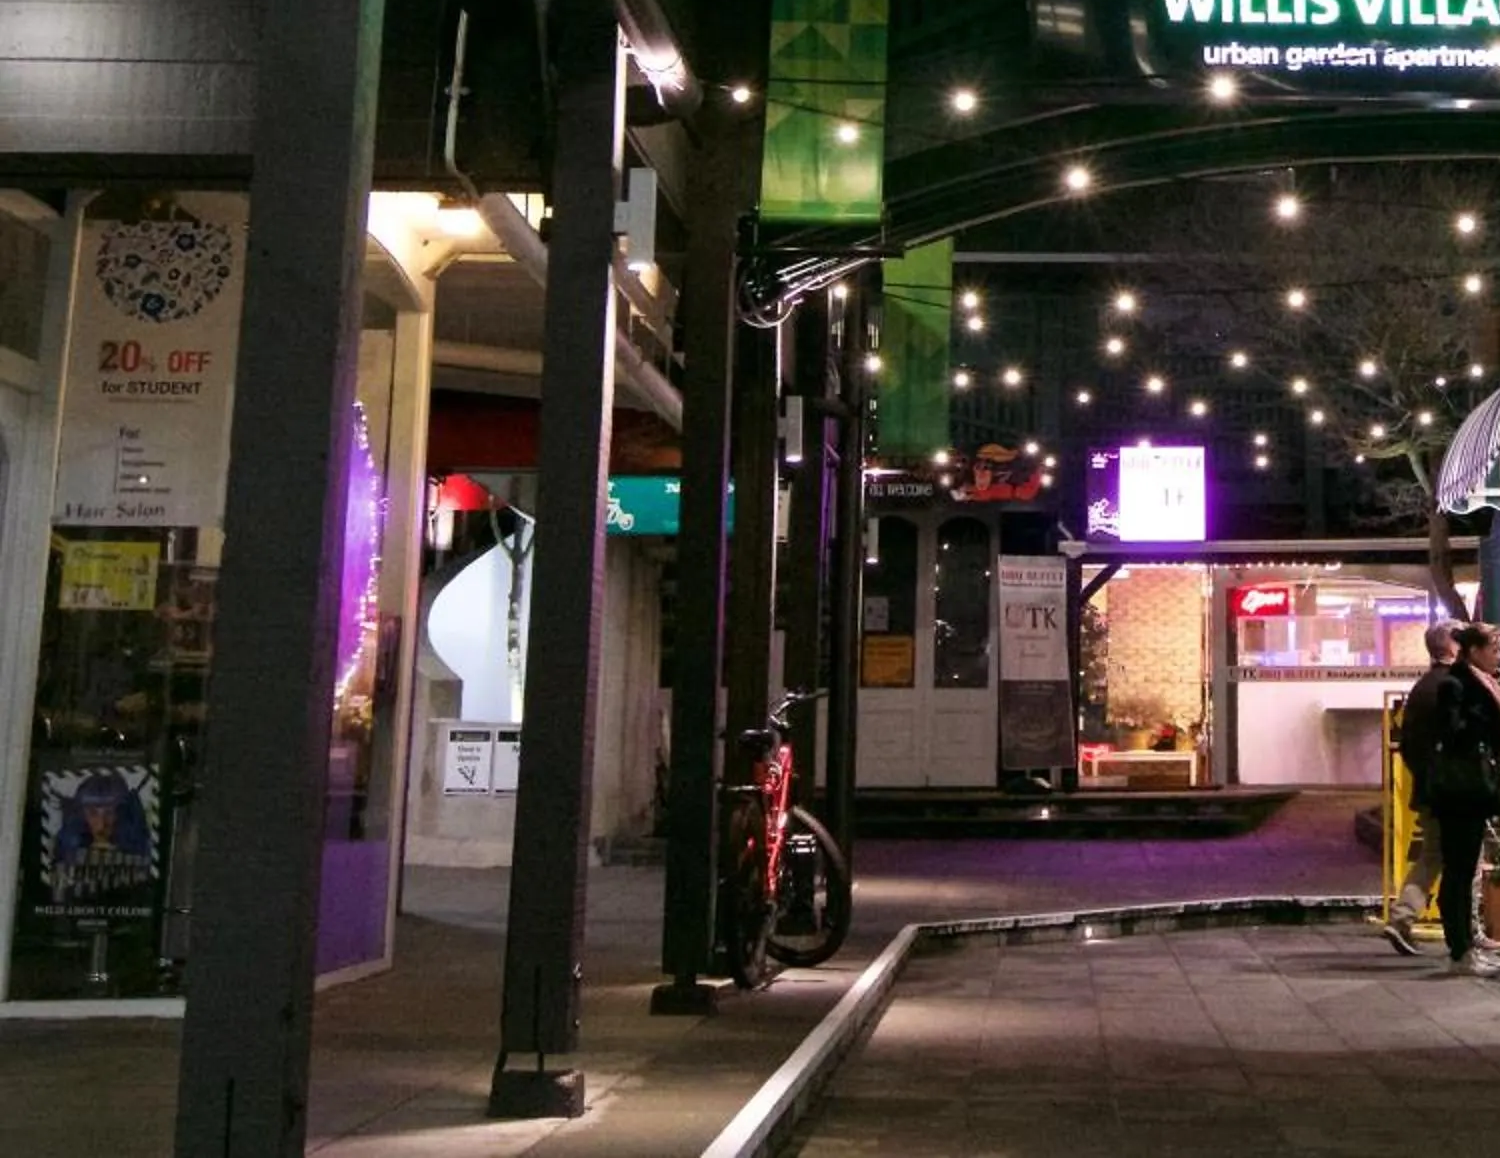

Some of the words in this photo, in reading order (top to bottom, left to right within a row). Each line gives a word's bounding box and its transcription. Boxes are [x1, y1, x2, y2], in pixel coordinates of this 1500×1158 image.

[1203, 42, 1279, 65] urban
[1285, 44, 1376, 71] garden
[167, 350, 213, 374] OFF
[101, 381, 123, 394] for
[126, 381, 203, 395] STUDENT
[64, 503, 106, 519] Hair
[116, 500, 166, 518] Salon
